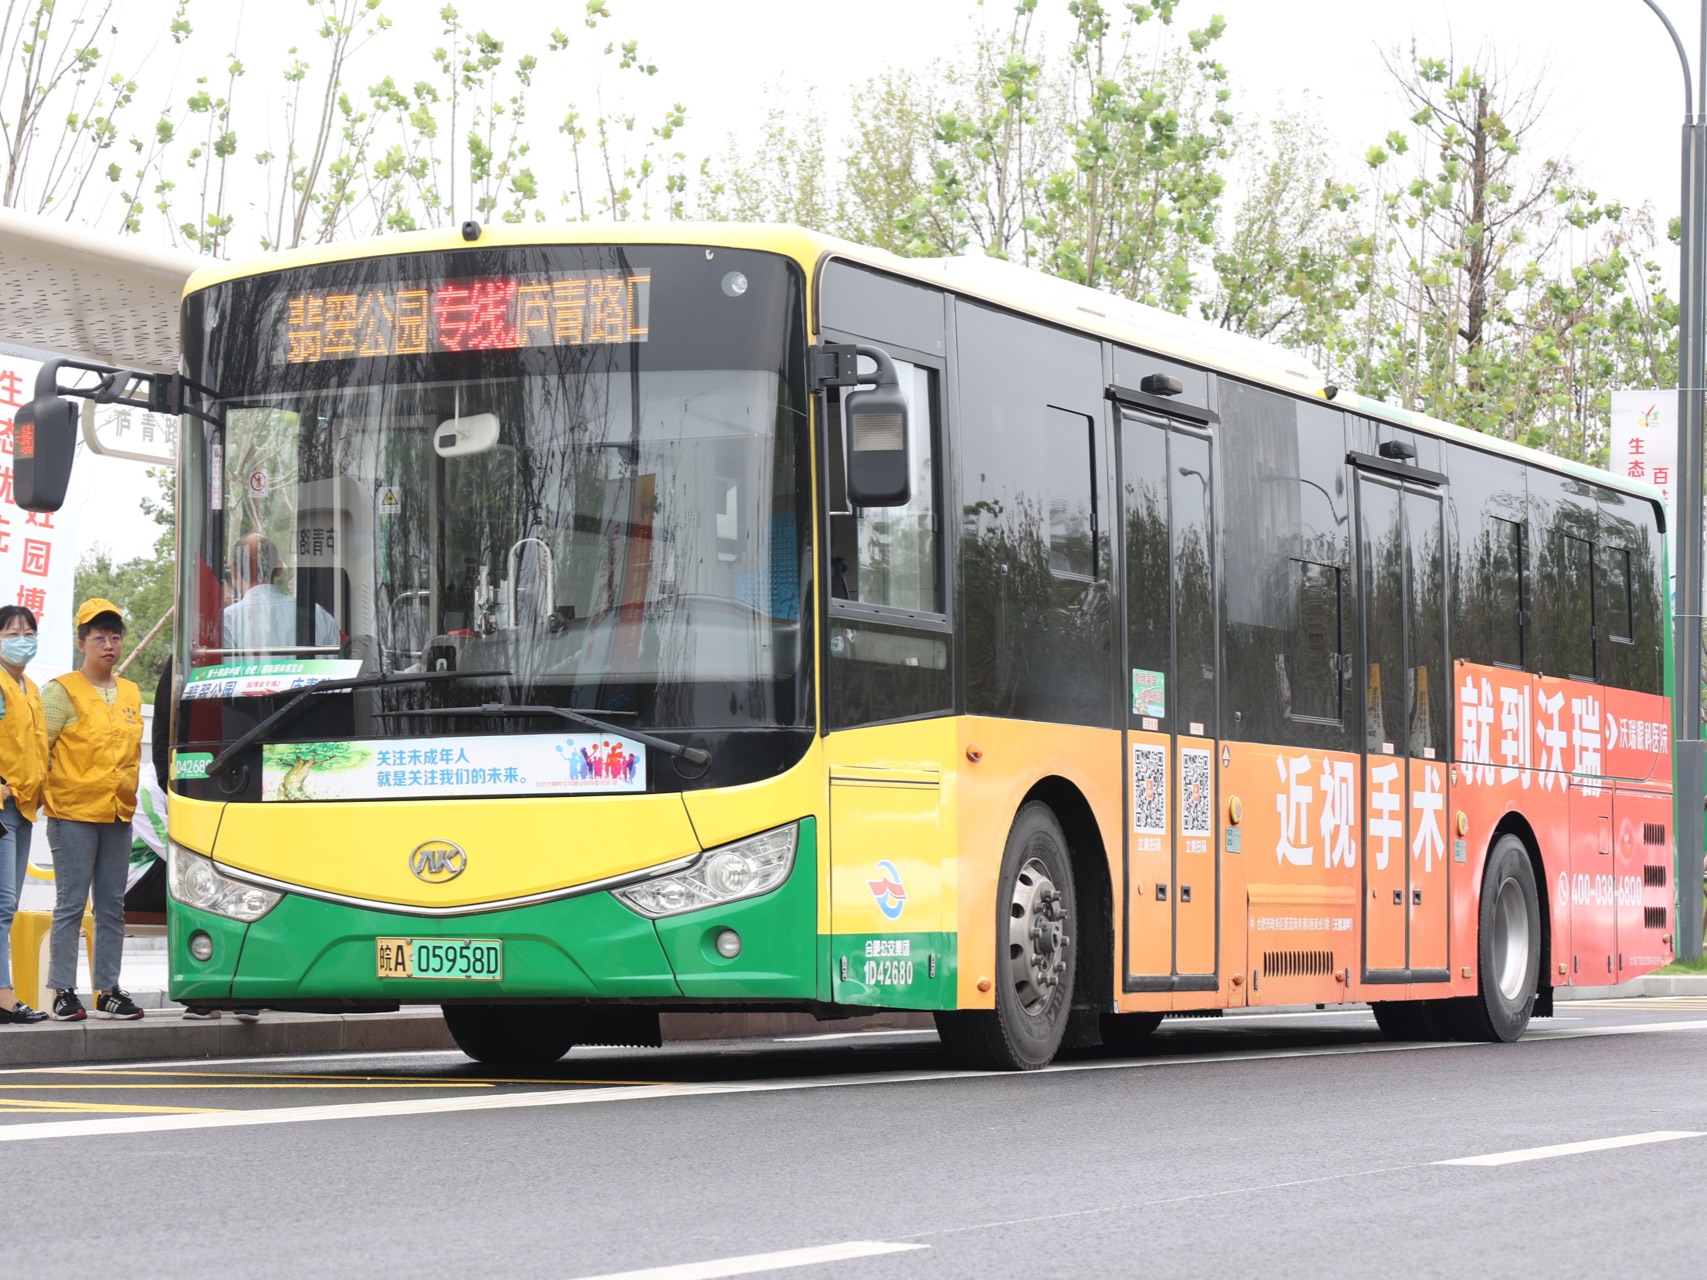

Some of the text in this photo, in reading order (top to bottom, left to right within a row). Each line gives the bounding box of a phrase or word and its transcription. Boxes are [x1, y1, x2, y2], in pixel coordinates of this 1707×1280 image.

[1628, 437, 1645, 478] 生态
[1460, 675, 1602, 797] 就到沃瑞
[1619, 717, 1669, 754] 沃瑞眼科医院
[376, 747, 470, 767] 关注未成年人
[376, 767, 527, 787] 就是关注我们的未来。
[1275, 754, 1445, 872] 近视手术
[1571, 873, 1642, 906] 400-038-6800
[865, 939, 911, 957] 合肥公交集团
[864, 960, 913, 985] 1D42680
